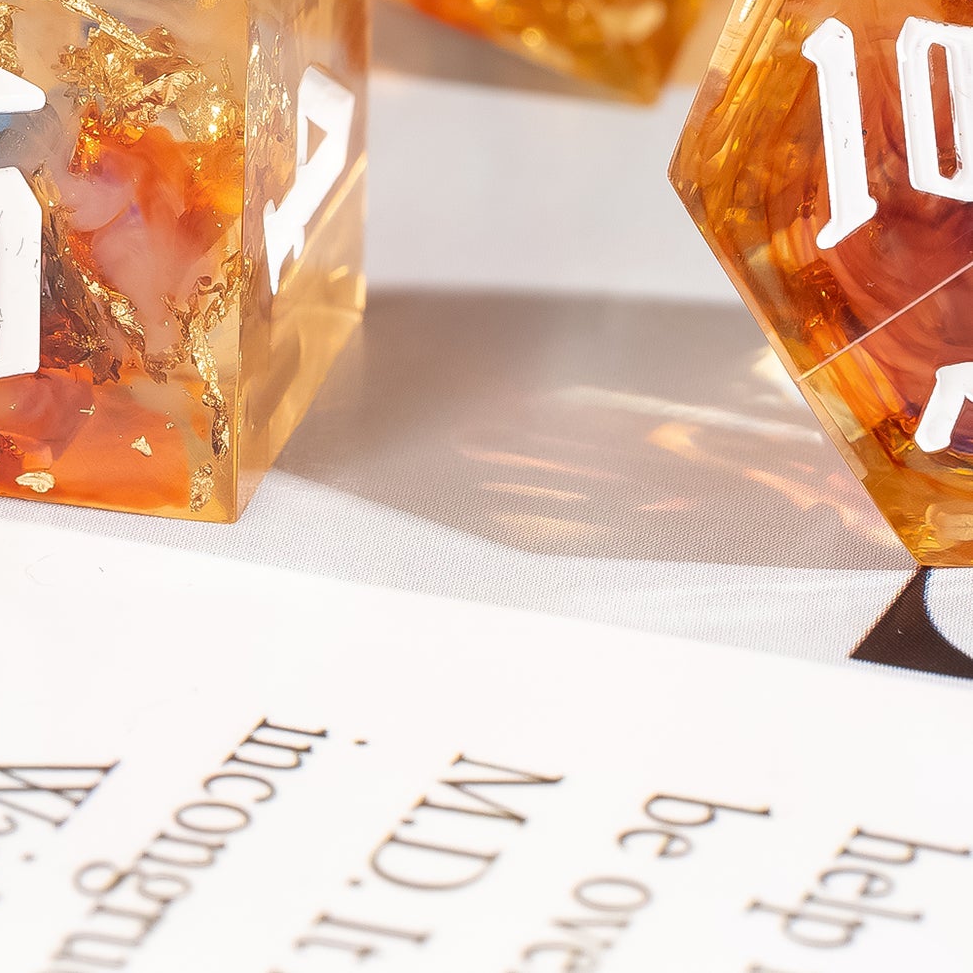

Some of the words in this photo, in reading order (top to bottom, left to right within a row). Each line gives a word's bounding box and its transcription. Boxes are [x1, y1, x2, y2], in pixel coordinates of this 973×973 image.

[263, 64, 356, 295] 4
[801, 16, 973, 250] 10
[37, 717, 369, 973] incongru
[347, 752, 564, 892] M.D.
[617, 792, 772, 859] be
[291, 908, 432, 963] It
[503, 875, 652, 973] ove
[744, 827, 973, 950] help
